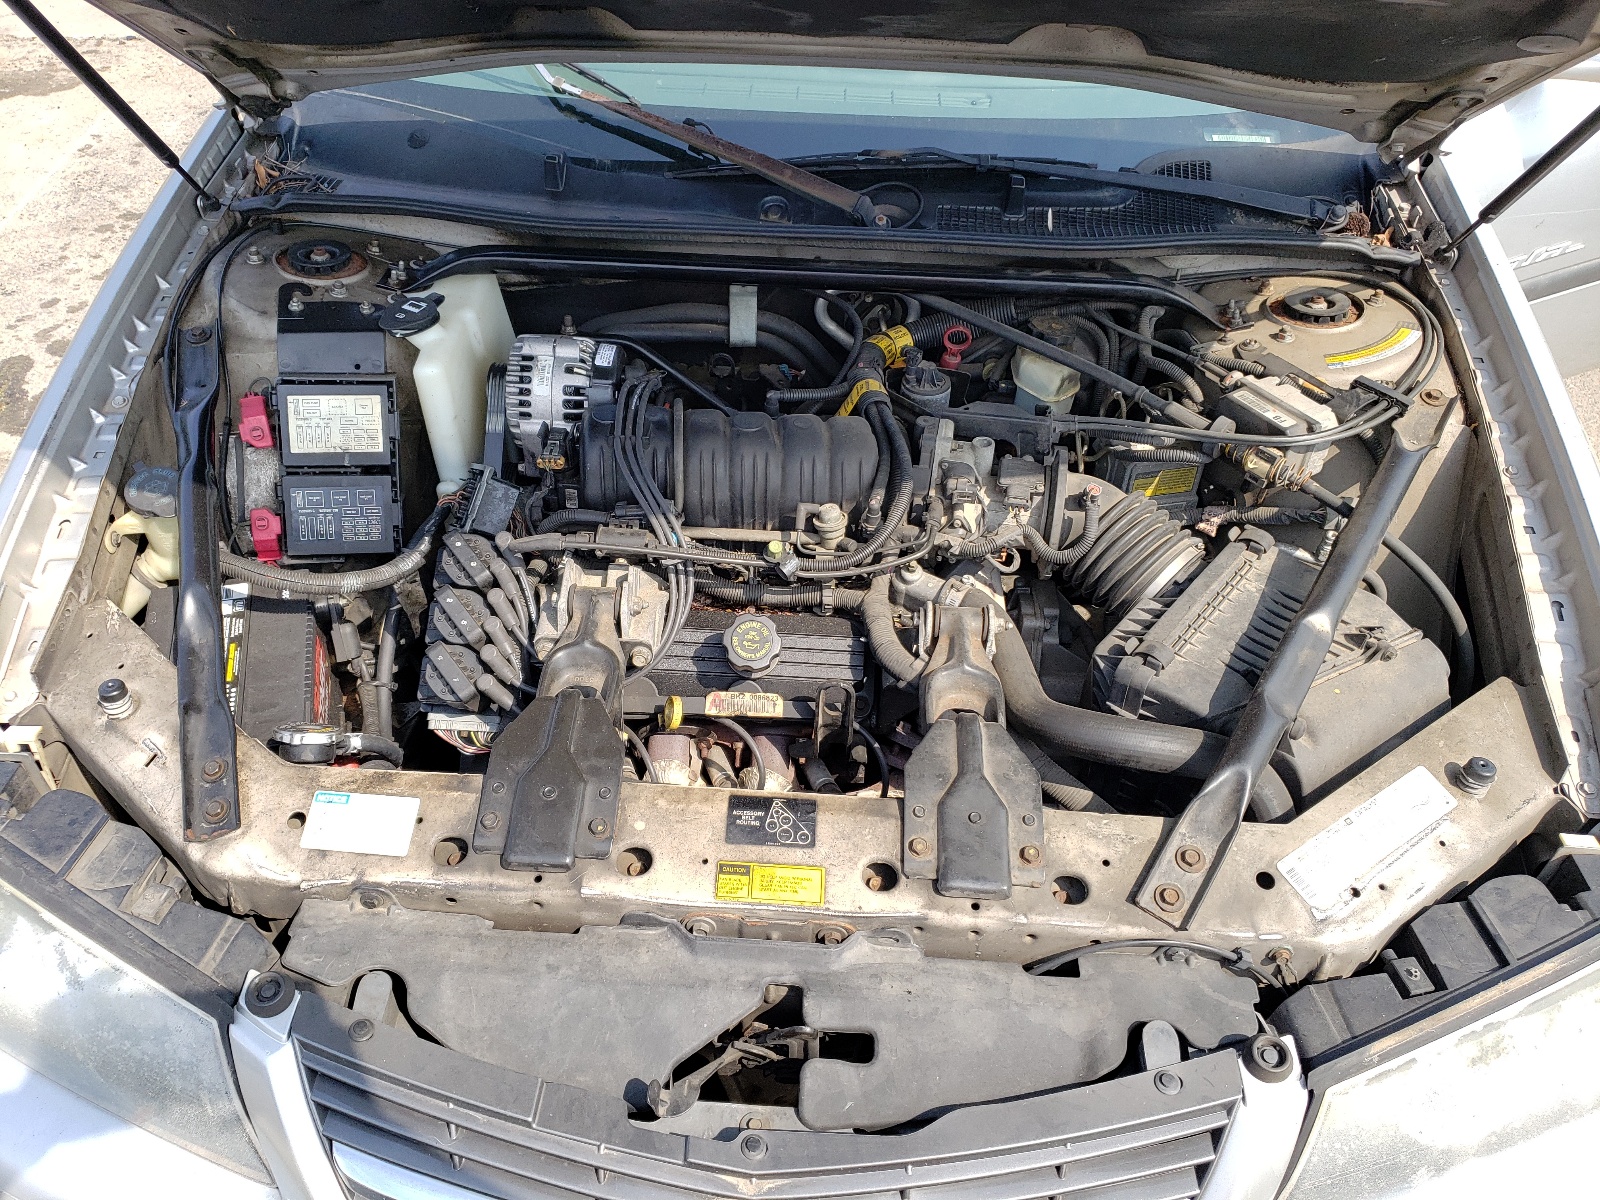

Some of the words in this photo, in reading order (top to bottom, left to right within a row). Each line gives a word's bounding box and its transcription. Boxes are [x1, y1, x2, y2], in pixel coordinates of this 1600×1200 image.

[737, 621, 762, 634] ENGINE
[760, 626, 770, 638] OIL
[732, 809, 765, 817] ACCESSORY
